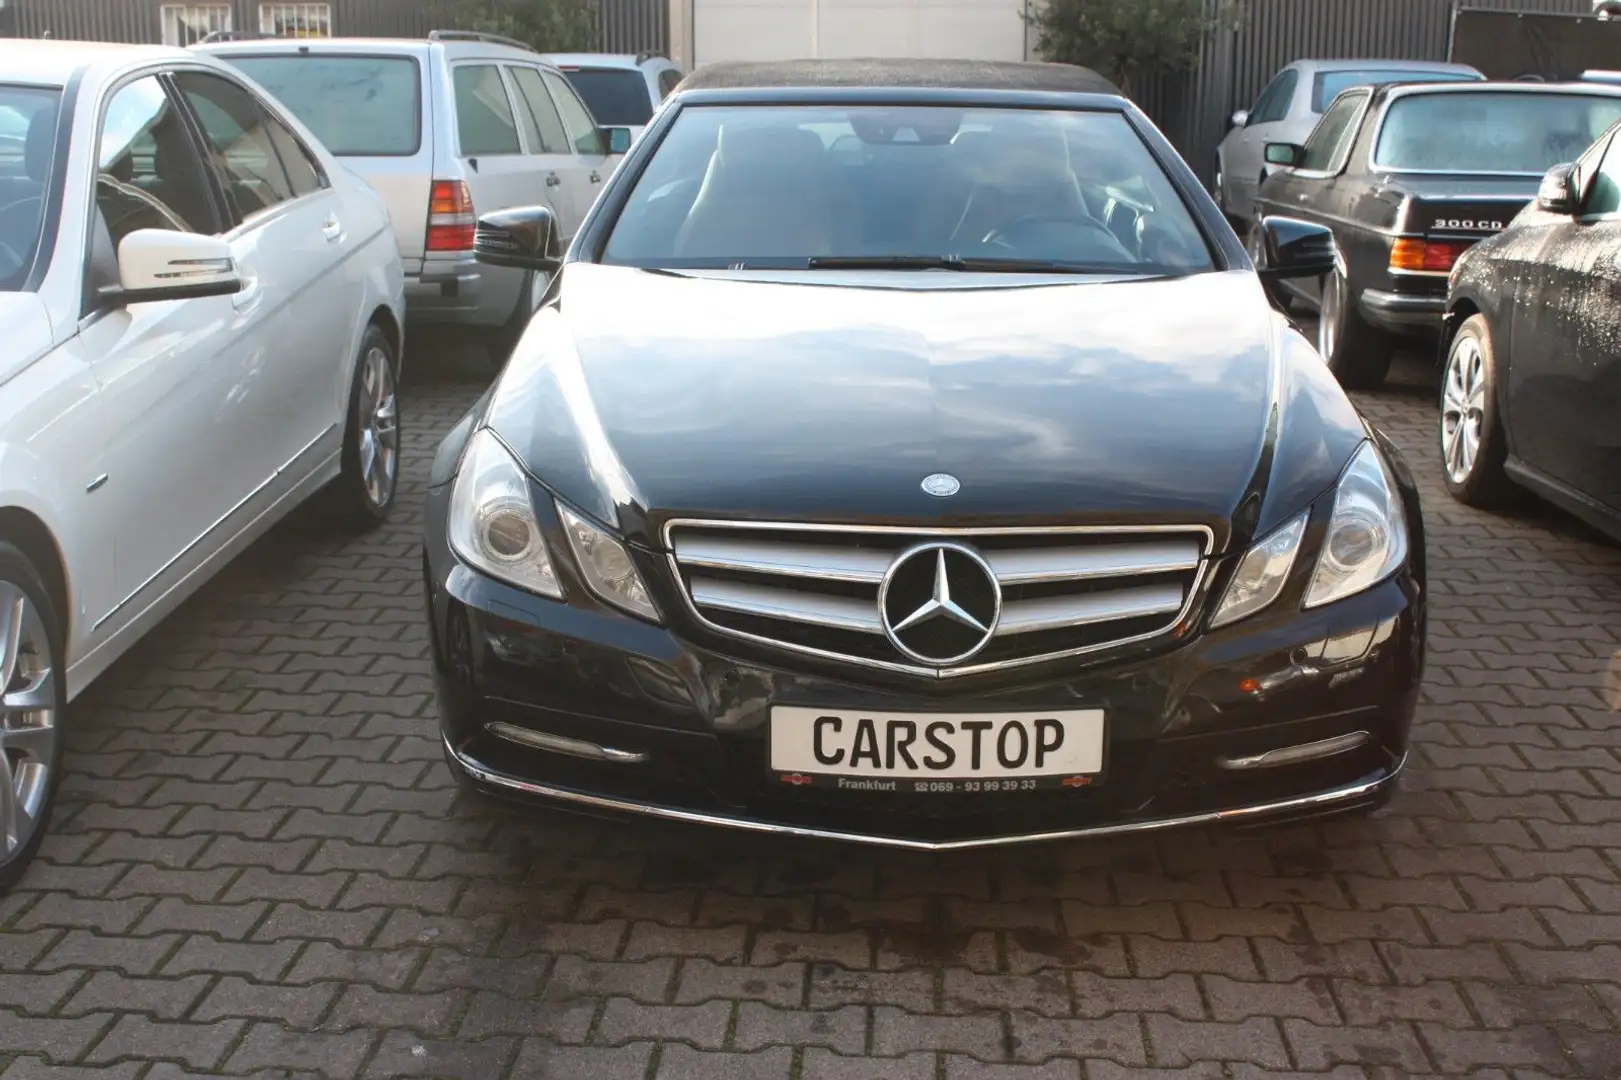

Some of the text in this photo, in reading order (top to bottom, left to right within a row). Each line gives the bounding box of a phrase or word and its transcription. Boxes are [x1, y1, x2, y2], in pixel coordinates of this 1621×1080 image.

[813, 716, 1064, 770] CARSTOP
[838, 778, 896, 791] Frankfurt
[930, 782, 953, 792] 069
[965, 781, 980, 792] 93
[984, 781, 999, 791] 99
[1002, 781, 1018, 791] 39
[1021, 780, 1036, 790] 33
